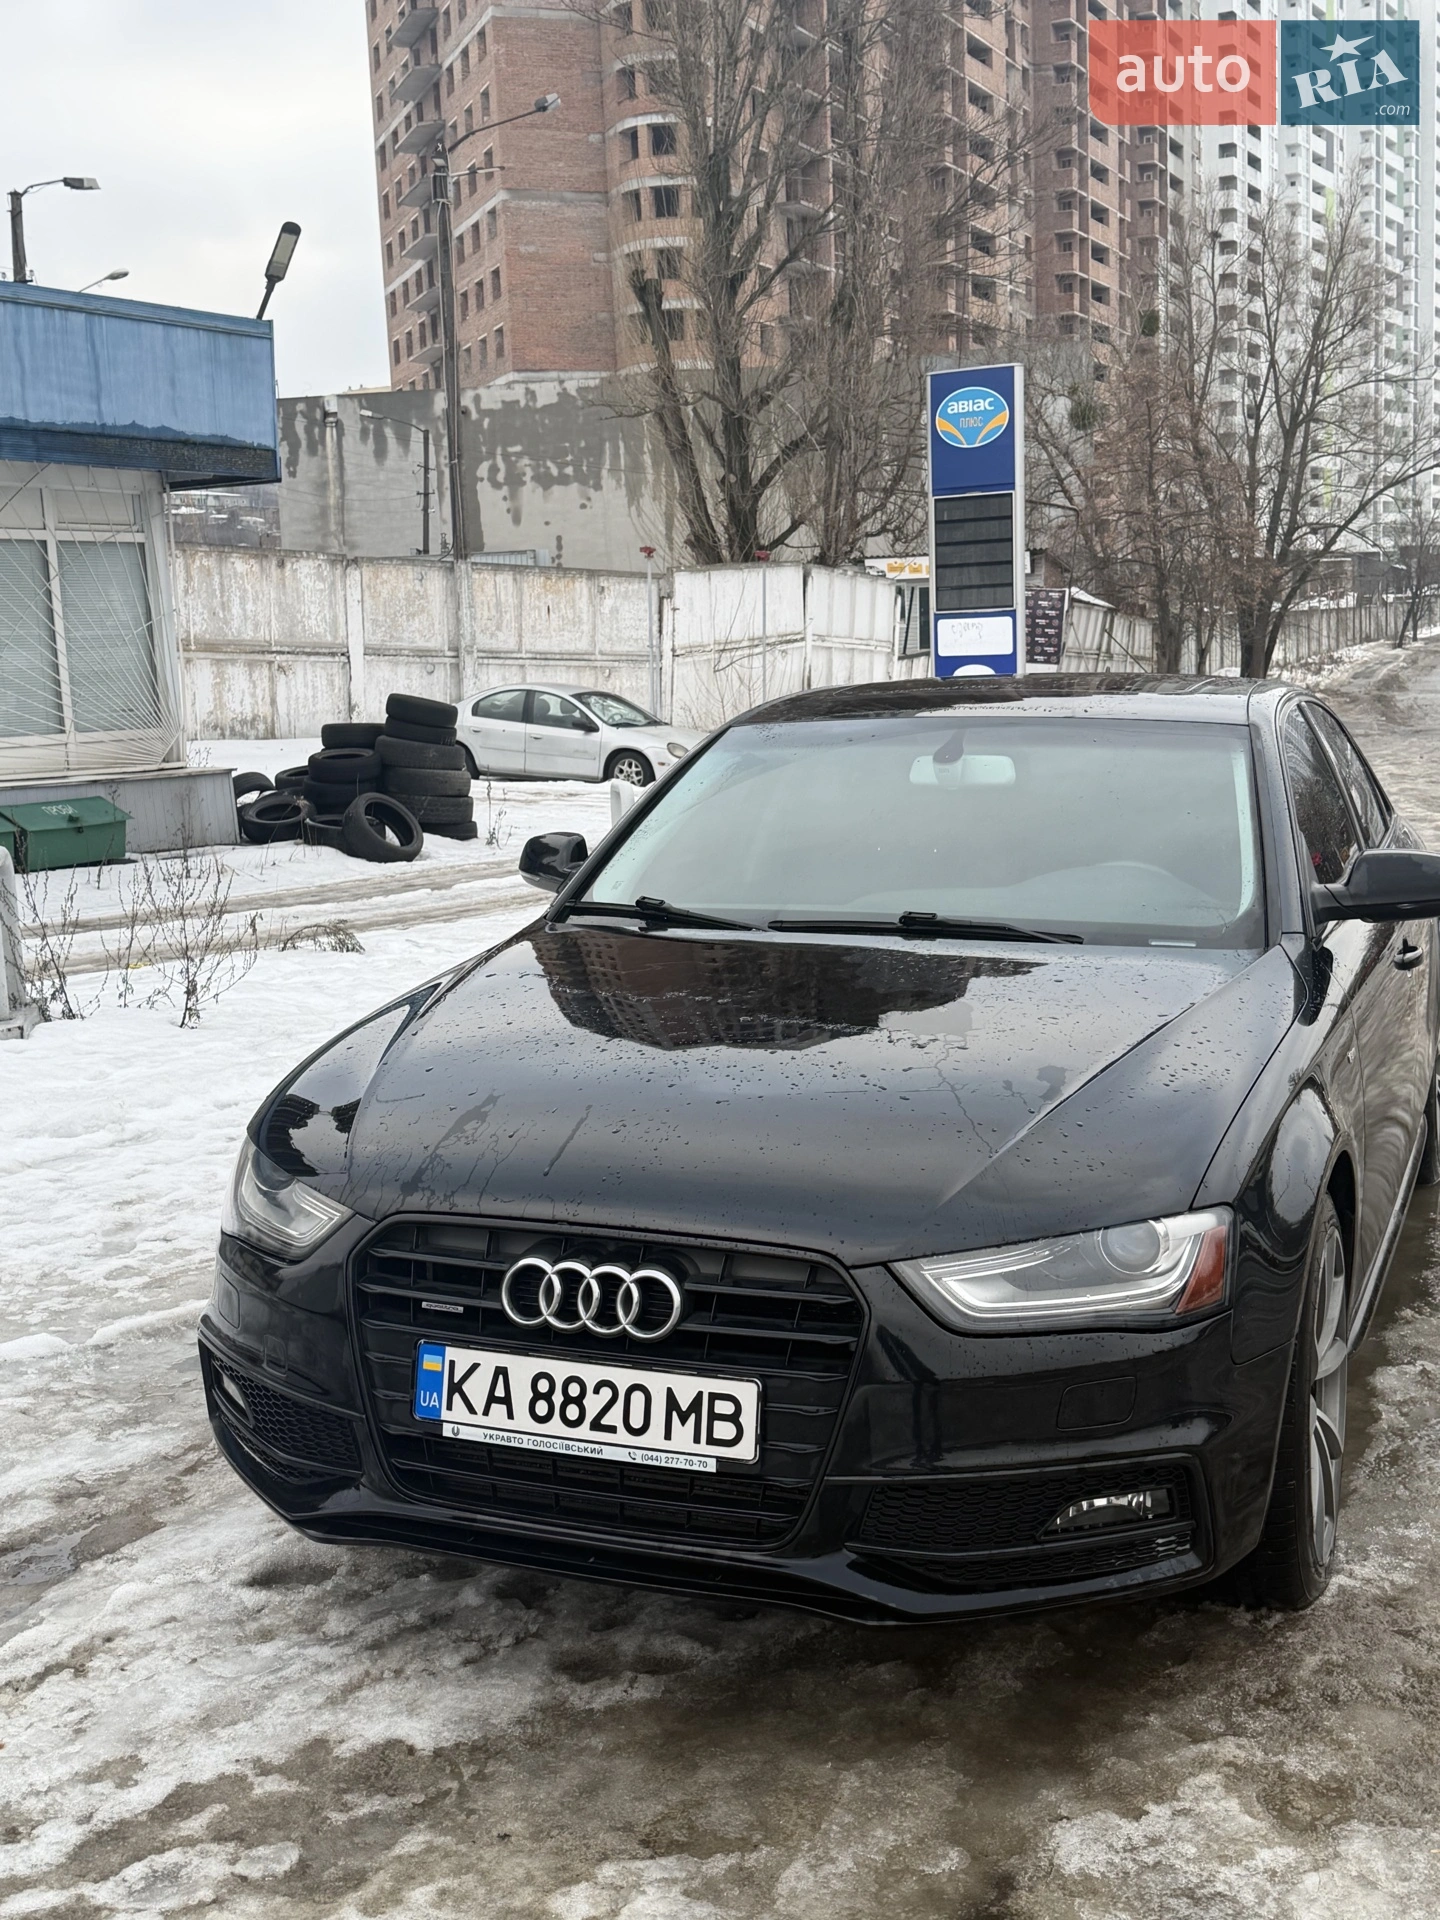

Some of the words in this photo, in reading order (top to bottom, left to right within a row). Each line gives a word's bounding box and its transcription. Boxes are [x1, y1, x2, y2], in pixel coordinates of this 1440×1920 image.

[419, 1390, 440, 1409] UA
[446, 1359, 515, 1421] KA
[528, 1371, 652, 1437] 8820
[663, 1386, 744, 1448] MB
[483, 1432, 524, 1445] УКРАВТО
[527, 1439, 604, 1456] ГОЛОСІЇВСЬКИЙ
[641, 1452, 663, 1465] (044)
[664, 1456, 708, 1469] 277-70-70
